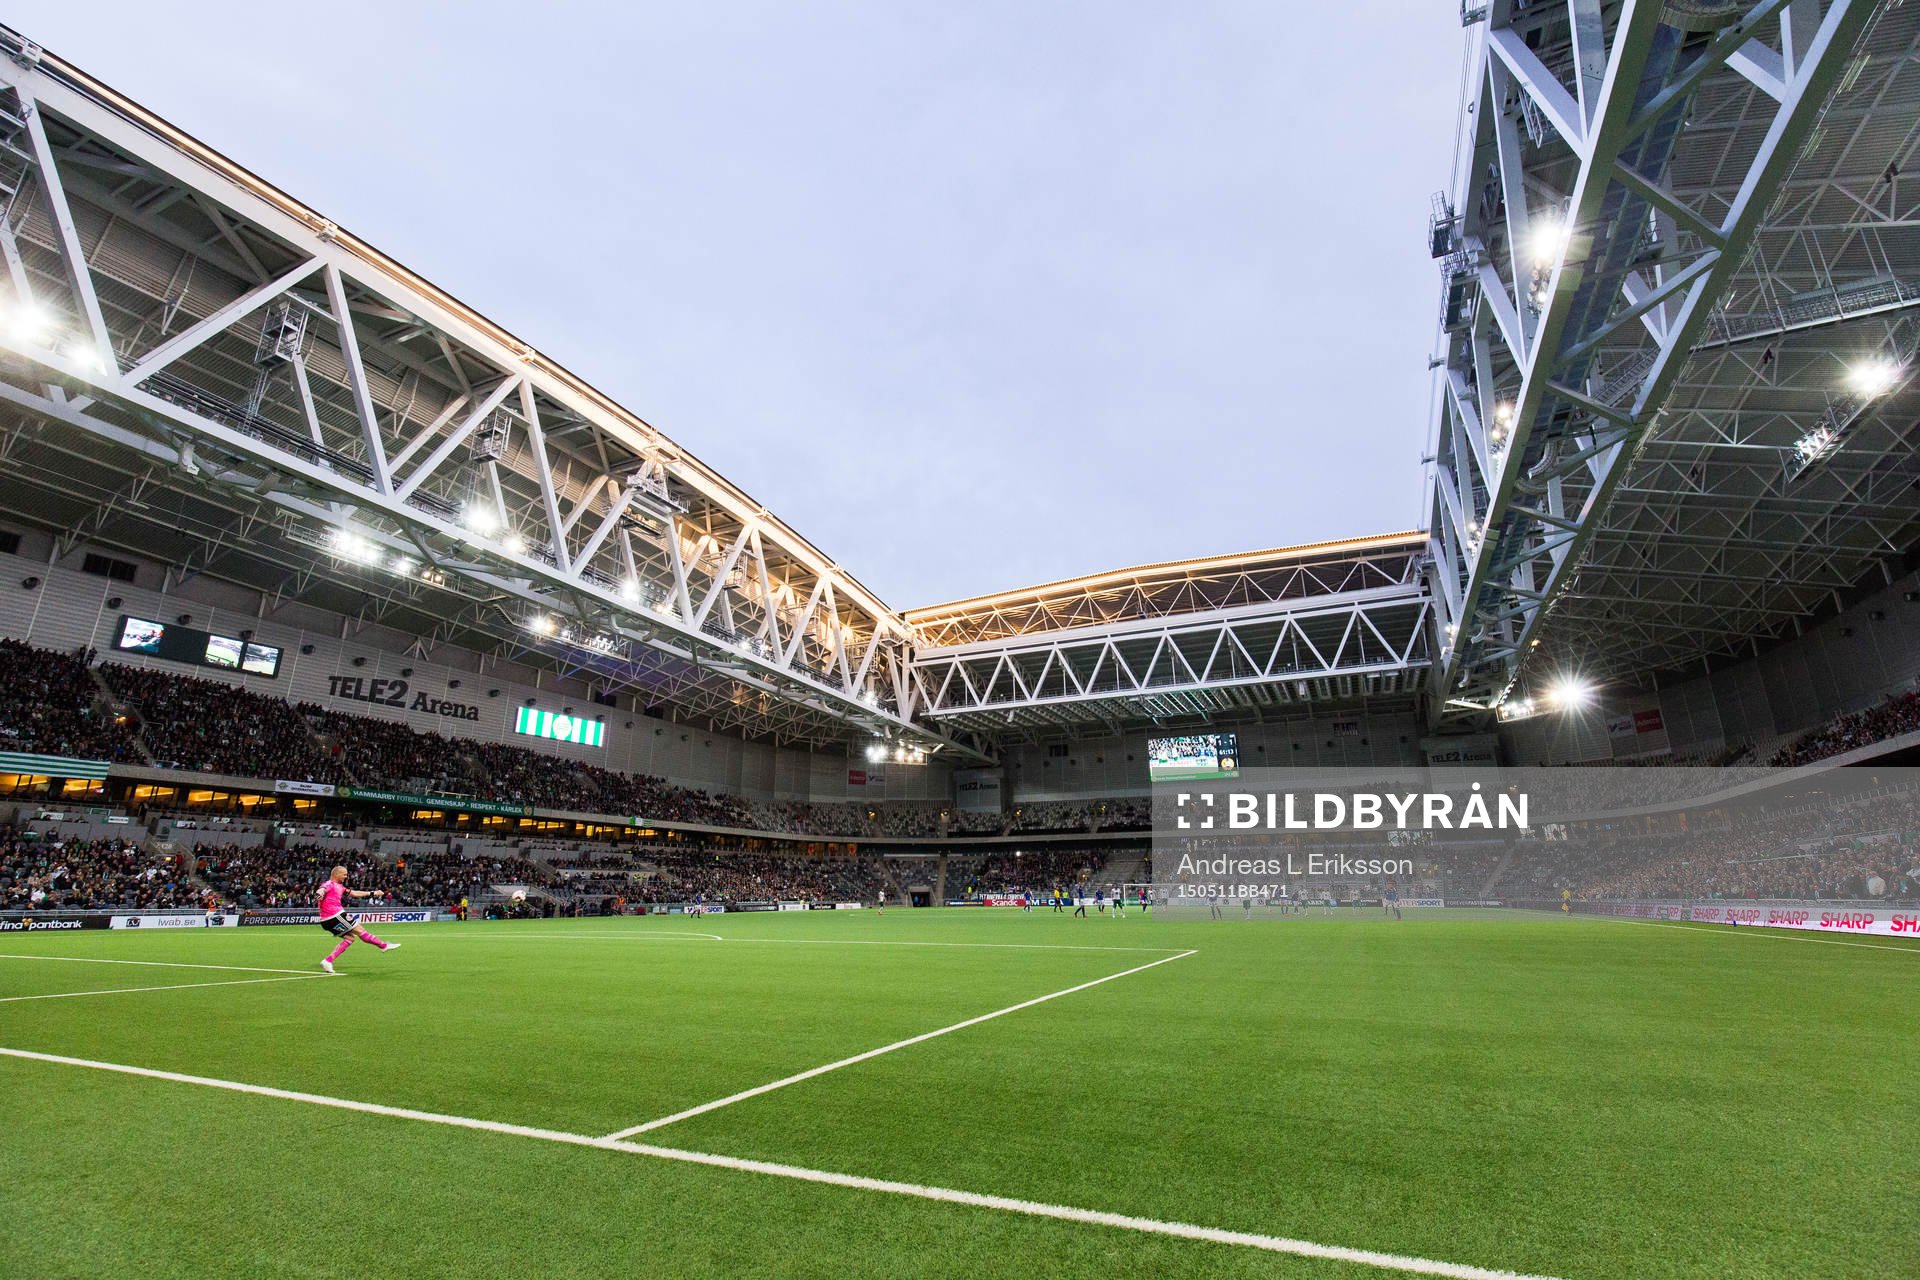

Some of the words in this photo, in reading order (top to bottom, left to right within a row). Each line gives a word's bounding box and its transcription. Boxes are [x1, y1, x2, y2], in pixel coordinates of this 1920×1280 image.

[328, 676, 409, 708] TELE2
[410, 691, 480, 721] Arena
[353, 790, 395, 800] HAMMARBY
[426, 798, 466, 807] GEMENSKAP
[470, 803, 496, 811] RESPEKT
[361, 913, 426, 922] INTERSPORT
[1693, 908, 1720, 920] SHARP
[1725, 909, 1760, 922] SHARP
[1769, 910, 1809, 925] SHARP
[1820, 912, 1875, 929] SHARP
[28, 920, 83, 931] pantbank
